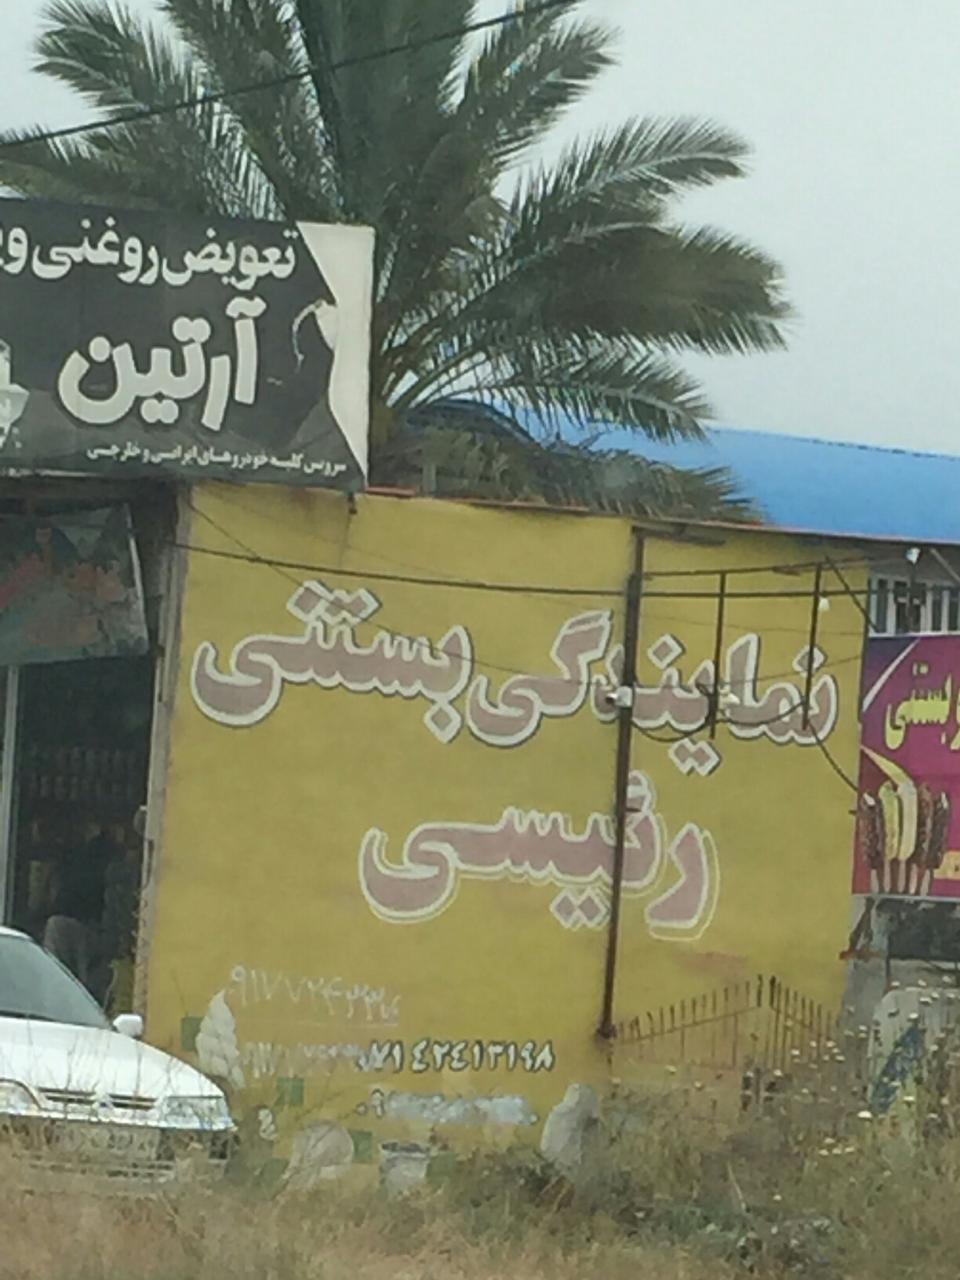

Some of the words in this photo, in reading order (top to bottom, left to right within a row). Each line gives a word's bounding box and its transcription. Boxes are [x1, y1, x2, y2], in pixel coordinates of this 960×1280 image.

[32, 216, 157, 285] روغنی
[162, 227, 299, 289] تعویض
[58, 296, 267, 432] آرتین
[192, 579, 473, 745] بستنی
[466, 609, 838, 776] نمایندگی
[884, 661, 954, 750] بستنی
[358, 770, 719, 940] رئیسی
